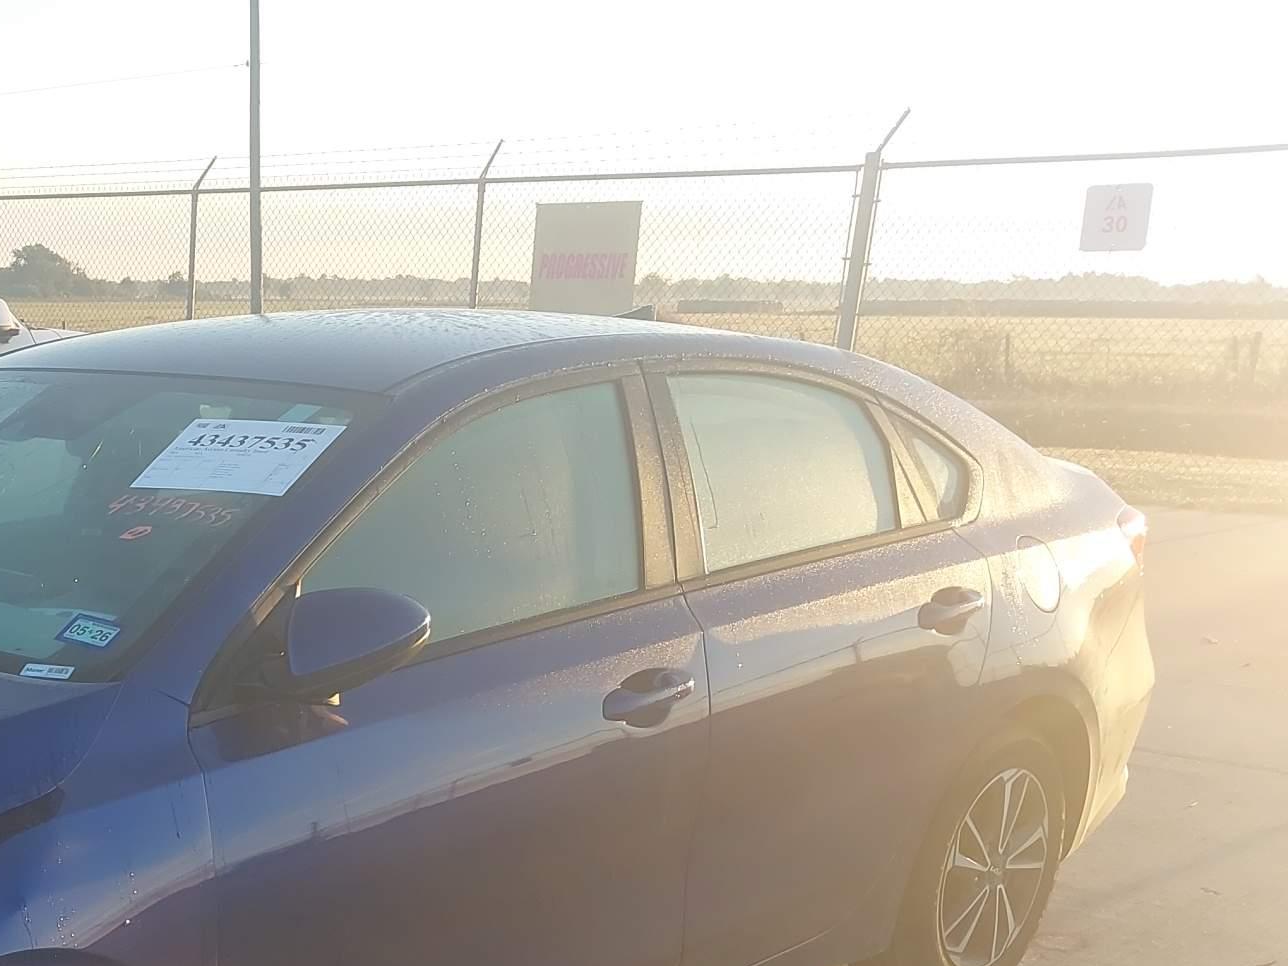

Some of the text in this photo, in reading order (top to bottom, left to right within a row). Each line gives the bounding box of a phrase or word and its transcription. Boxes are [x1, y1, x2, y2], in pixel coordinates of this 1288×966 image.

[1101, 215, 1129, 234] 30
[538, 252, 629, 280] PROGRESSIVE
[187, 433, 317, 452] 43437535
